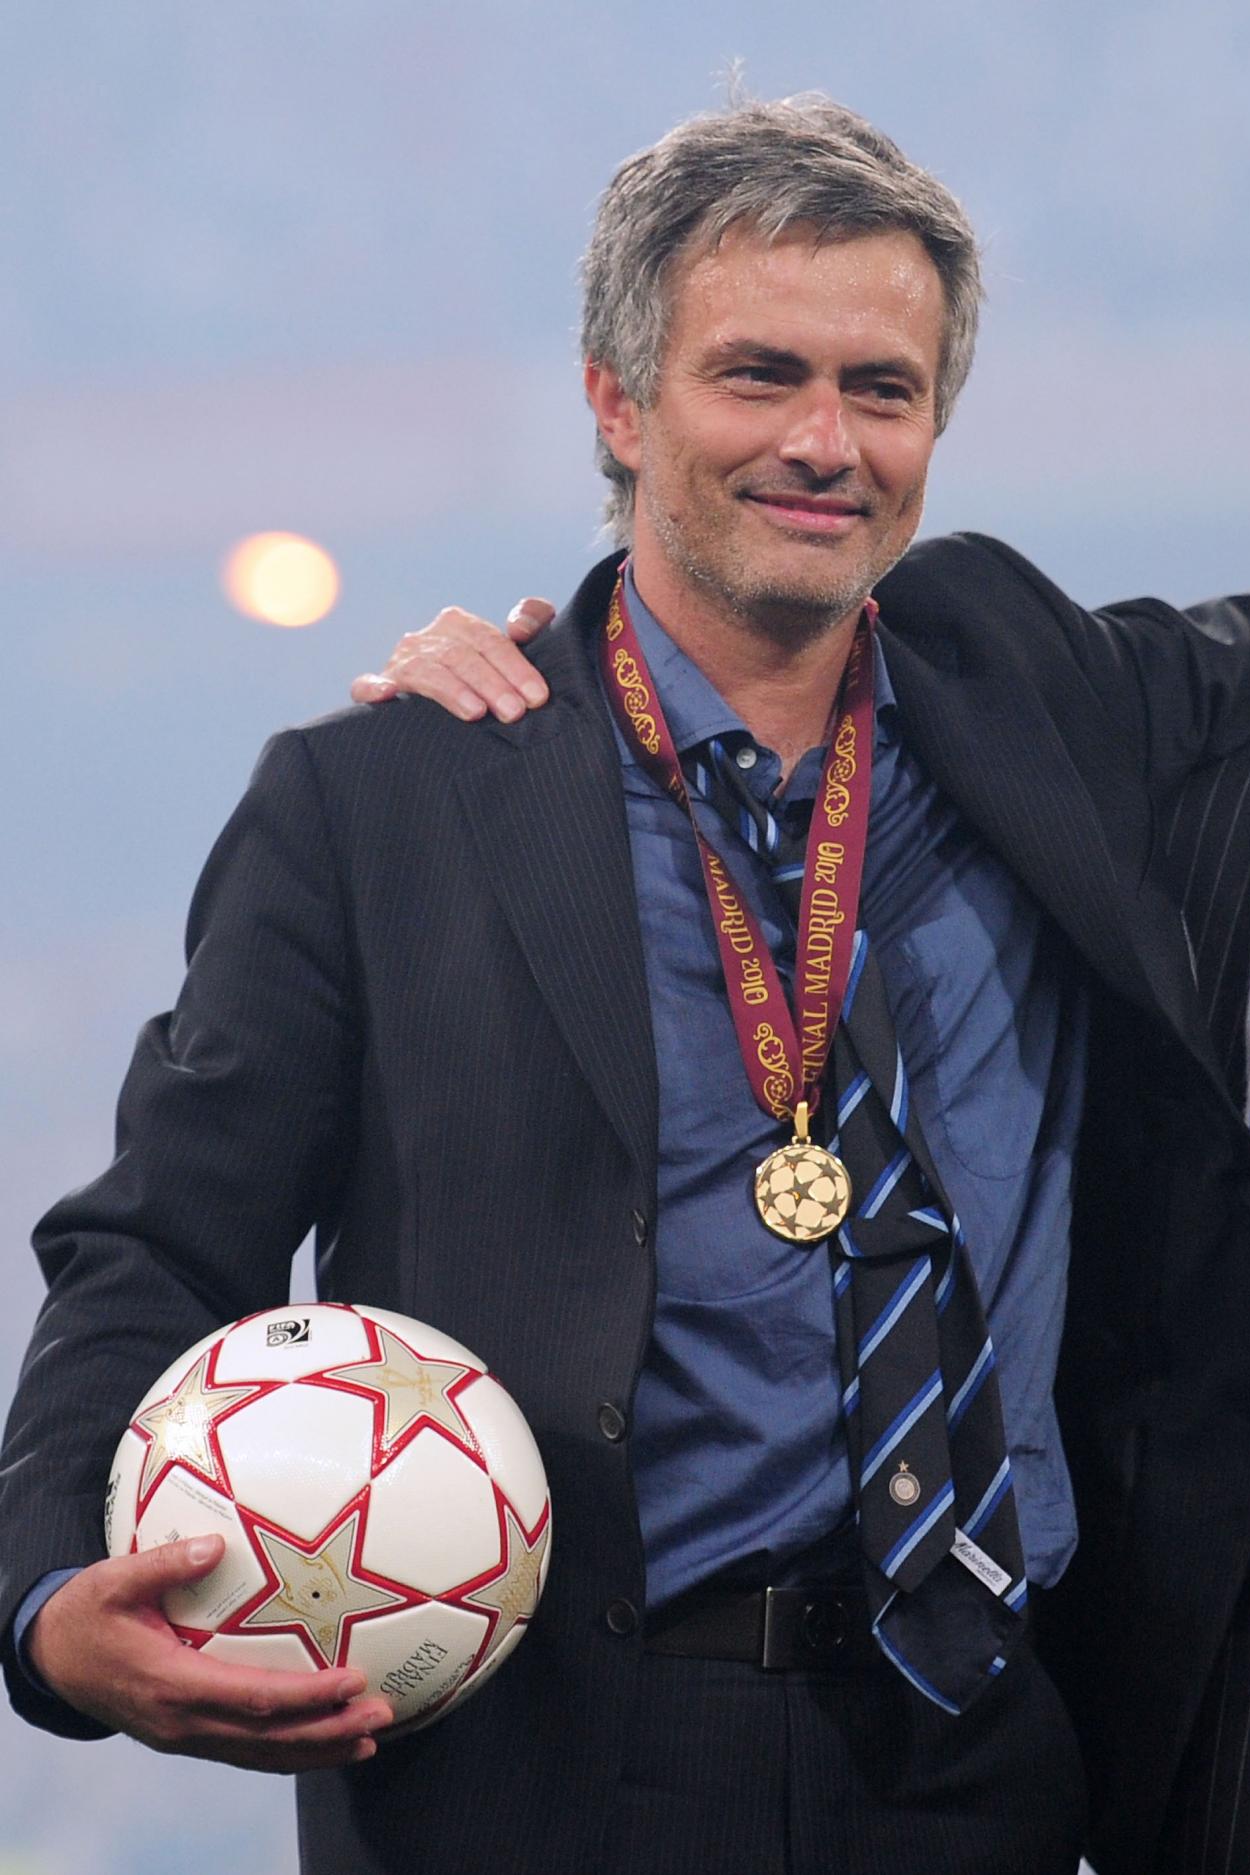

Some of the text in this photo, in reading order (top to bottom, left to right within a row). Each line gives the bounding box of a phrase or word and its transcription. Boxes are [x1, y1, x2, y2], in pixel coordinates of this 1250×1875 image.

[707, 854, 769, 1006] MADRID 2010
[802, 841, 845, 1086] FINAL MADRID 2010
